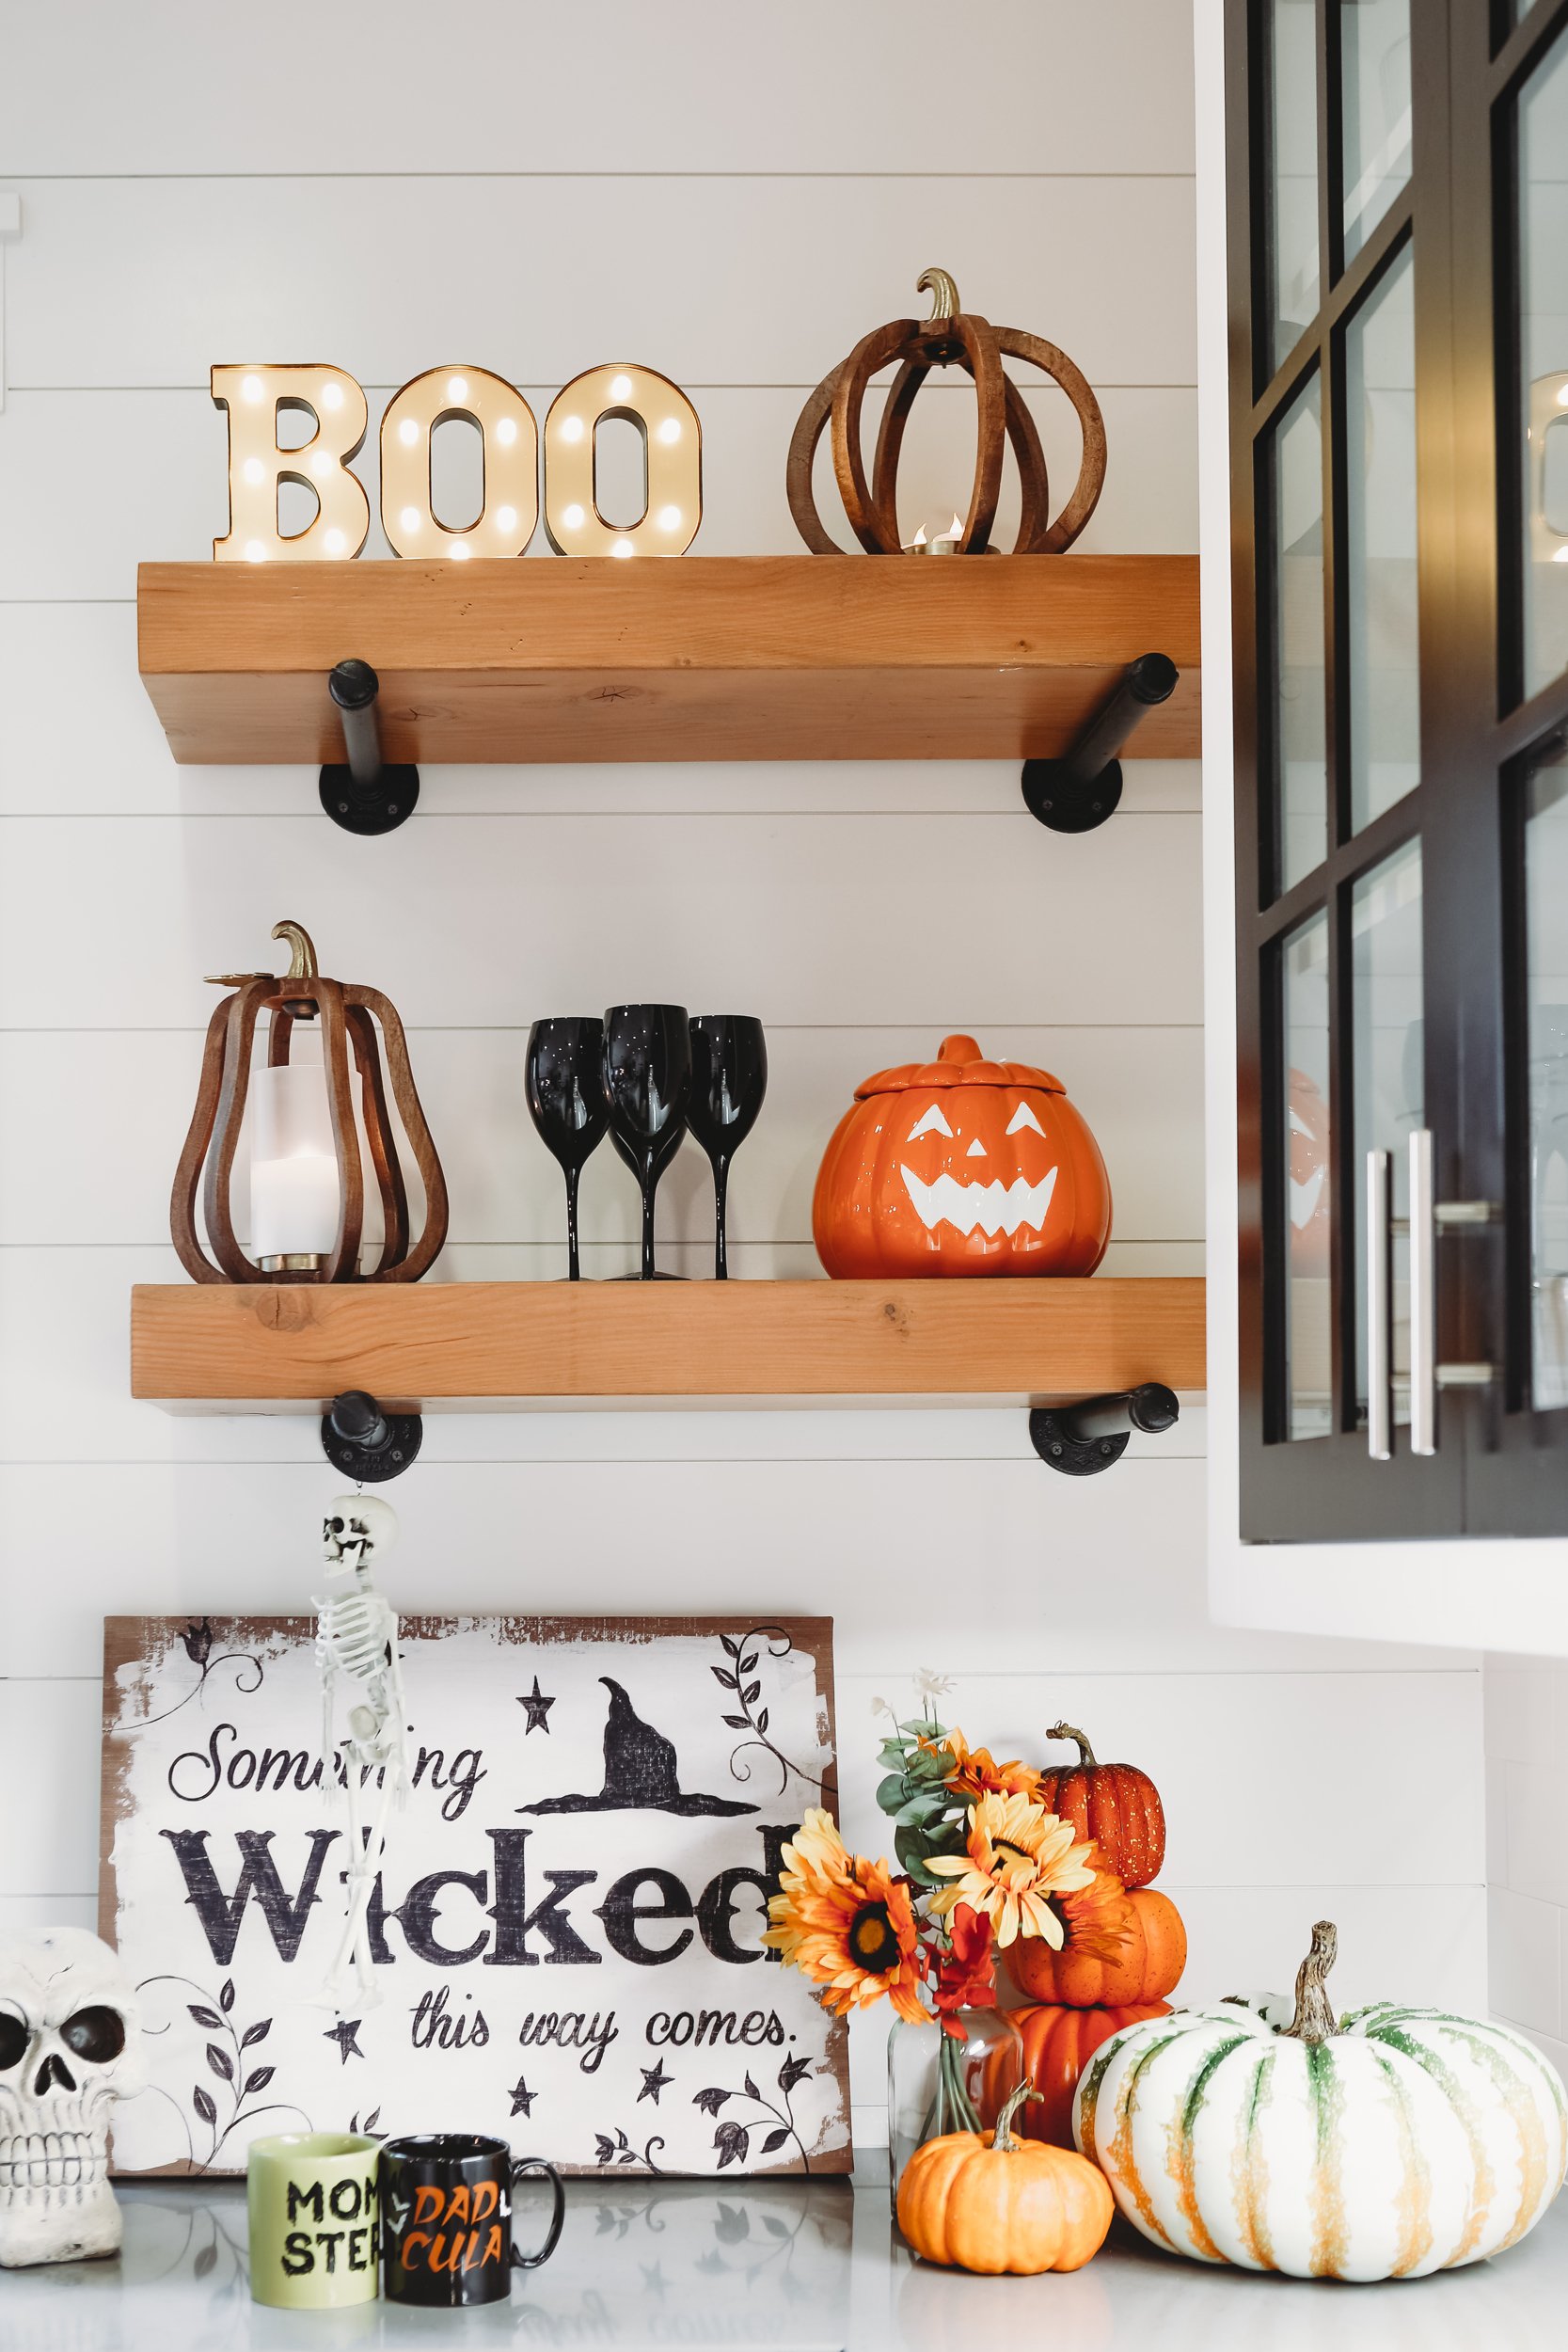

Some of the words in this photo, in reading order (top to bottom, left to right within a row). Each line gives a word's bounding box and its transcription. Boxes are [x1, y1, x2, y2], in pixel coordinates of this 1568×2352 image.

[211, 363, 703, 561] BOO
[408, 1984, 490, 2049] this
[518, 2010, 619, 2074] way
[645, 2009, 797, 2047] comes.
[413, 2180, 499, 2227] DAD
[401, 2223, 503, 2274] CULA
